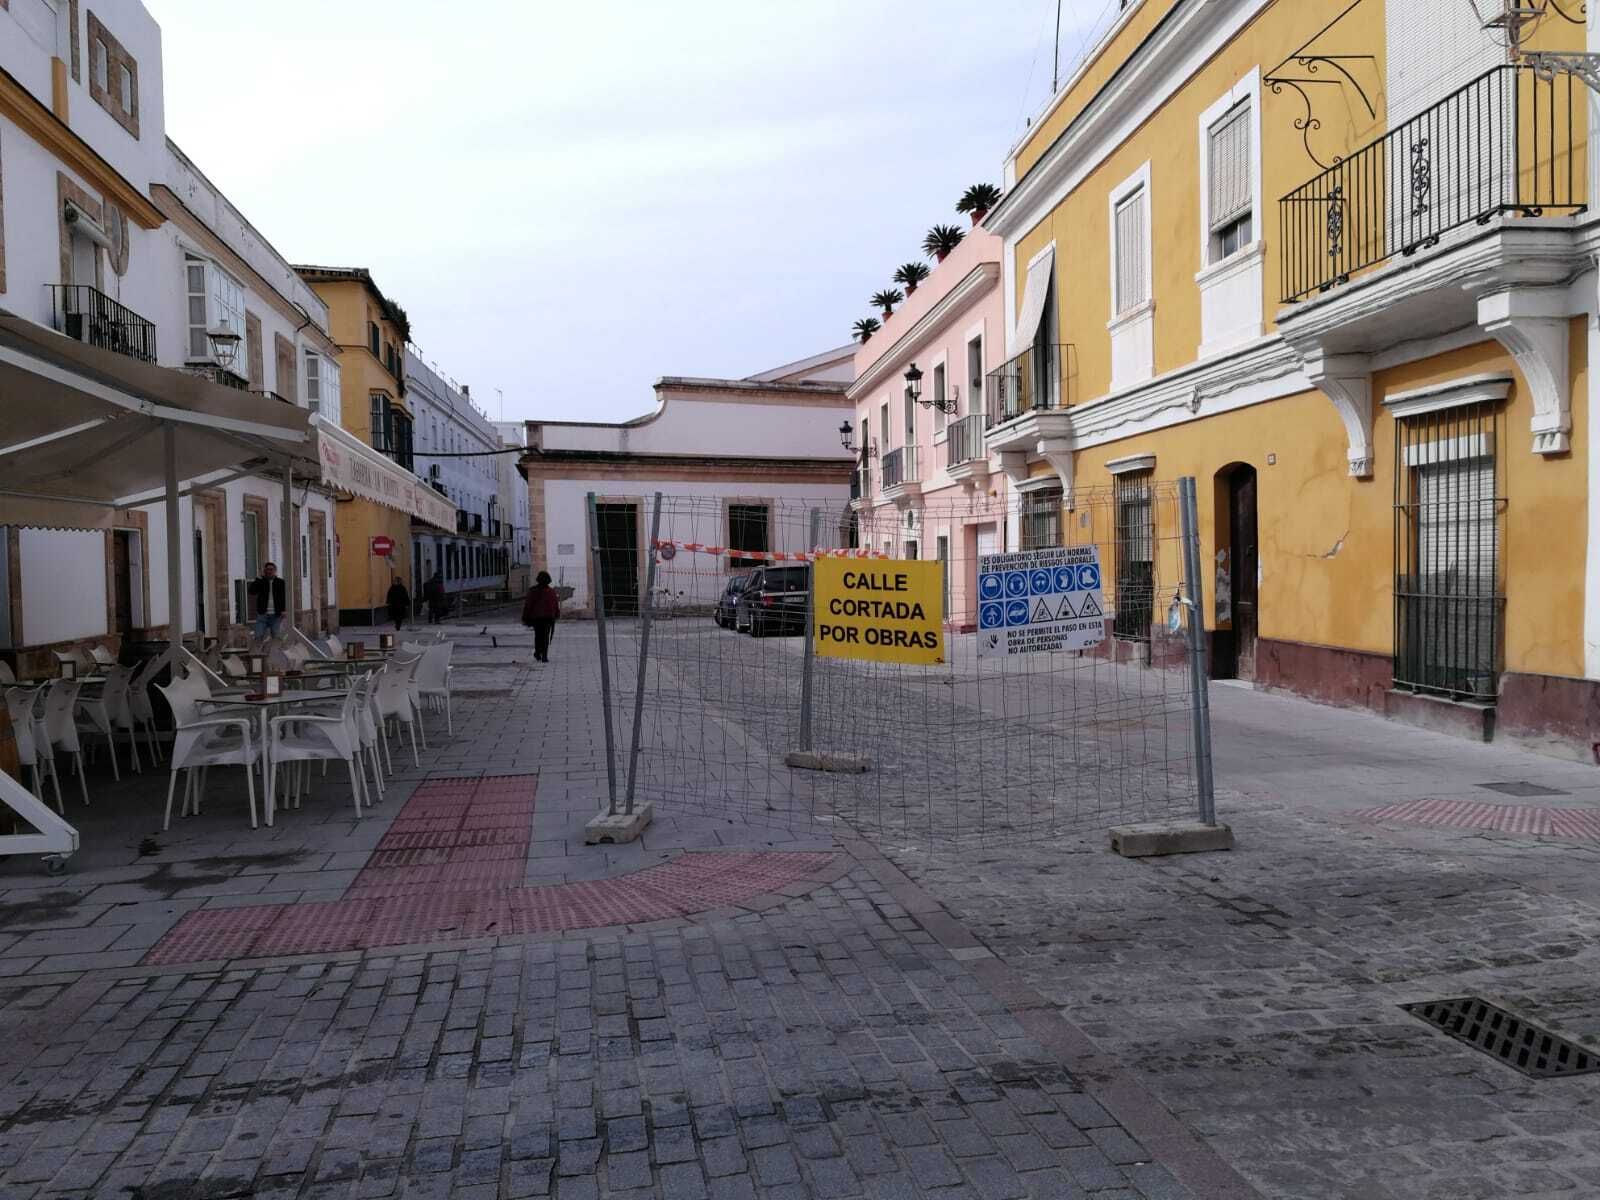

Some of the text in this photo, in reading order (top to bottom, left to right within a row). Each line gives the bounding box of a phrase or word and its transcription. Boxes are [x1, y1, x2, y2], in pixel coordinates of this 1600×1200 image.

[982, 565, 989, 574] DE
[1030, 559, 1038, 568] DE
[1039, 558, 1063, 568] RIESGOS
[1064, 555, 1096, 566] LABORALES
[983, 547, 1092, 565] ES OBLIGATORIO SEGUIR LAS NORMAS
[843, 572, 908, 591] CALLE
[829, 598, 925, 620] CORTADA
[820, 624, 938, 649] POR OBRAS
[1007, 621, 1102, 638] NO SE PERMITE EL PASO EN ESTA
[1008, 633, 1068, 646] OBRA DE PERSONAS
[1008, 642, 1063, 654] NO AUTORIZADAS
